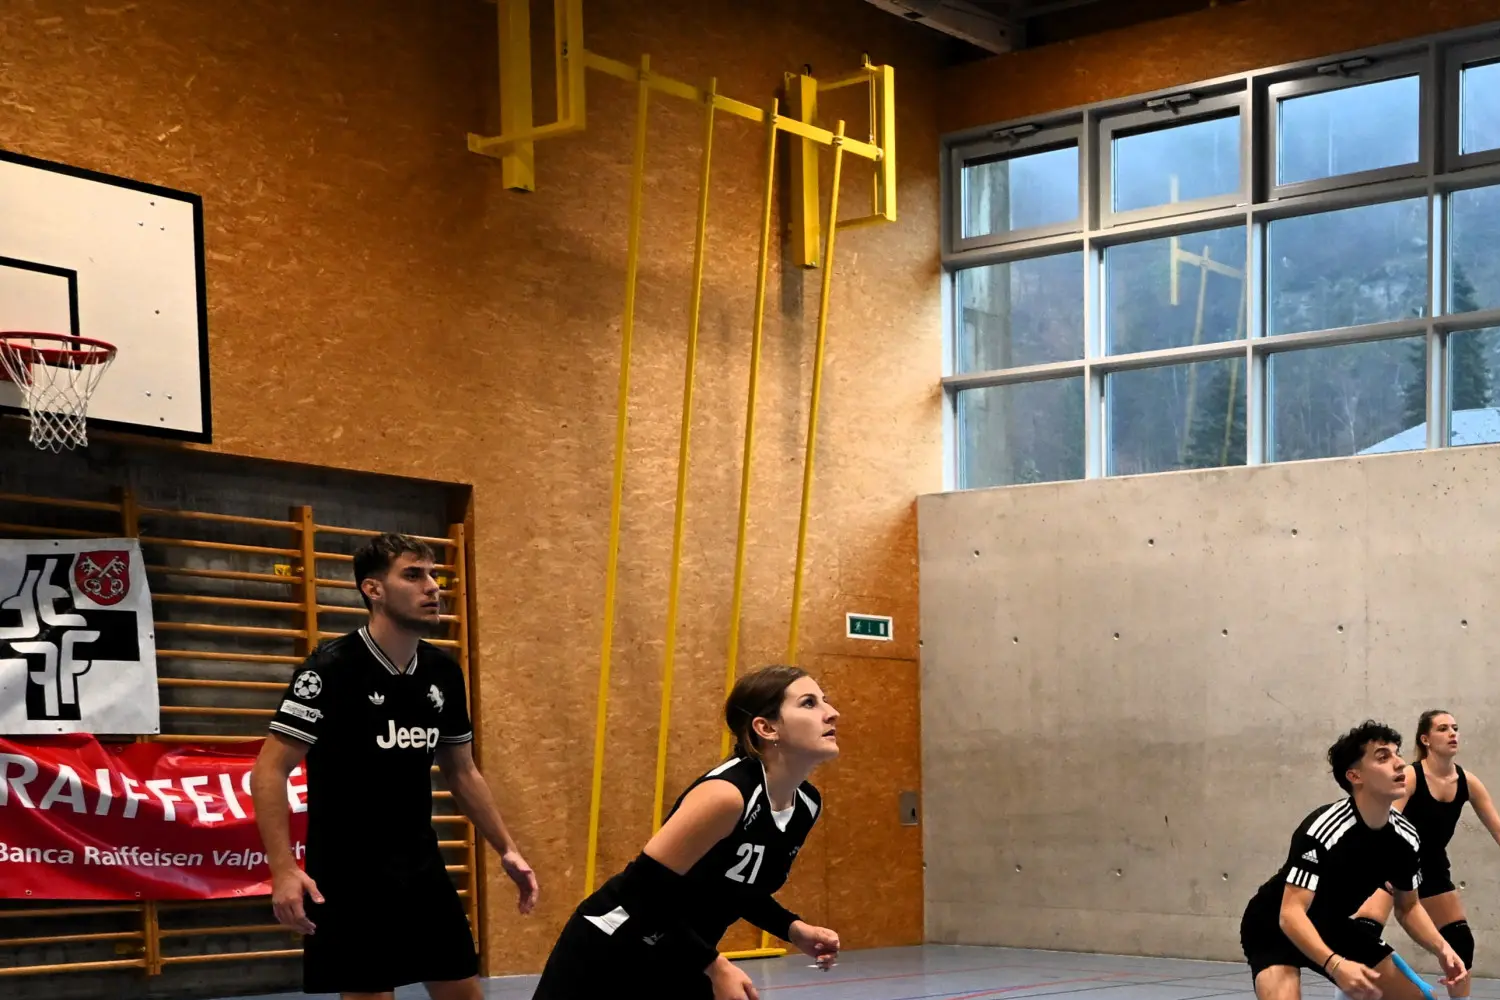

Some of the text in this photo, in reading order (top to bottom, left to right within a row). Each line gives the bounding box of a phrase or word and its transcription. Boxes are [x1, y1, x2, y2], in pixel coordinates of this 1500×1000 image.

[376, 719, 440, 754] Jeep
[0, 752, 308, 822] RAIFFEIE
[83, 845, 203, 866] Raiffeisen
[724, 842, 766, 884] 27
